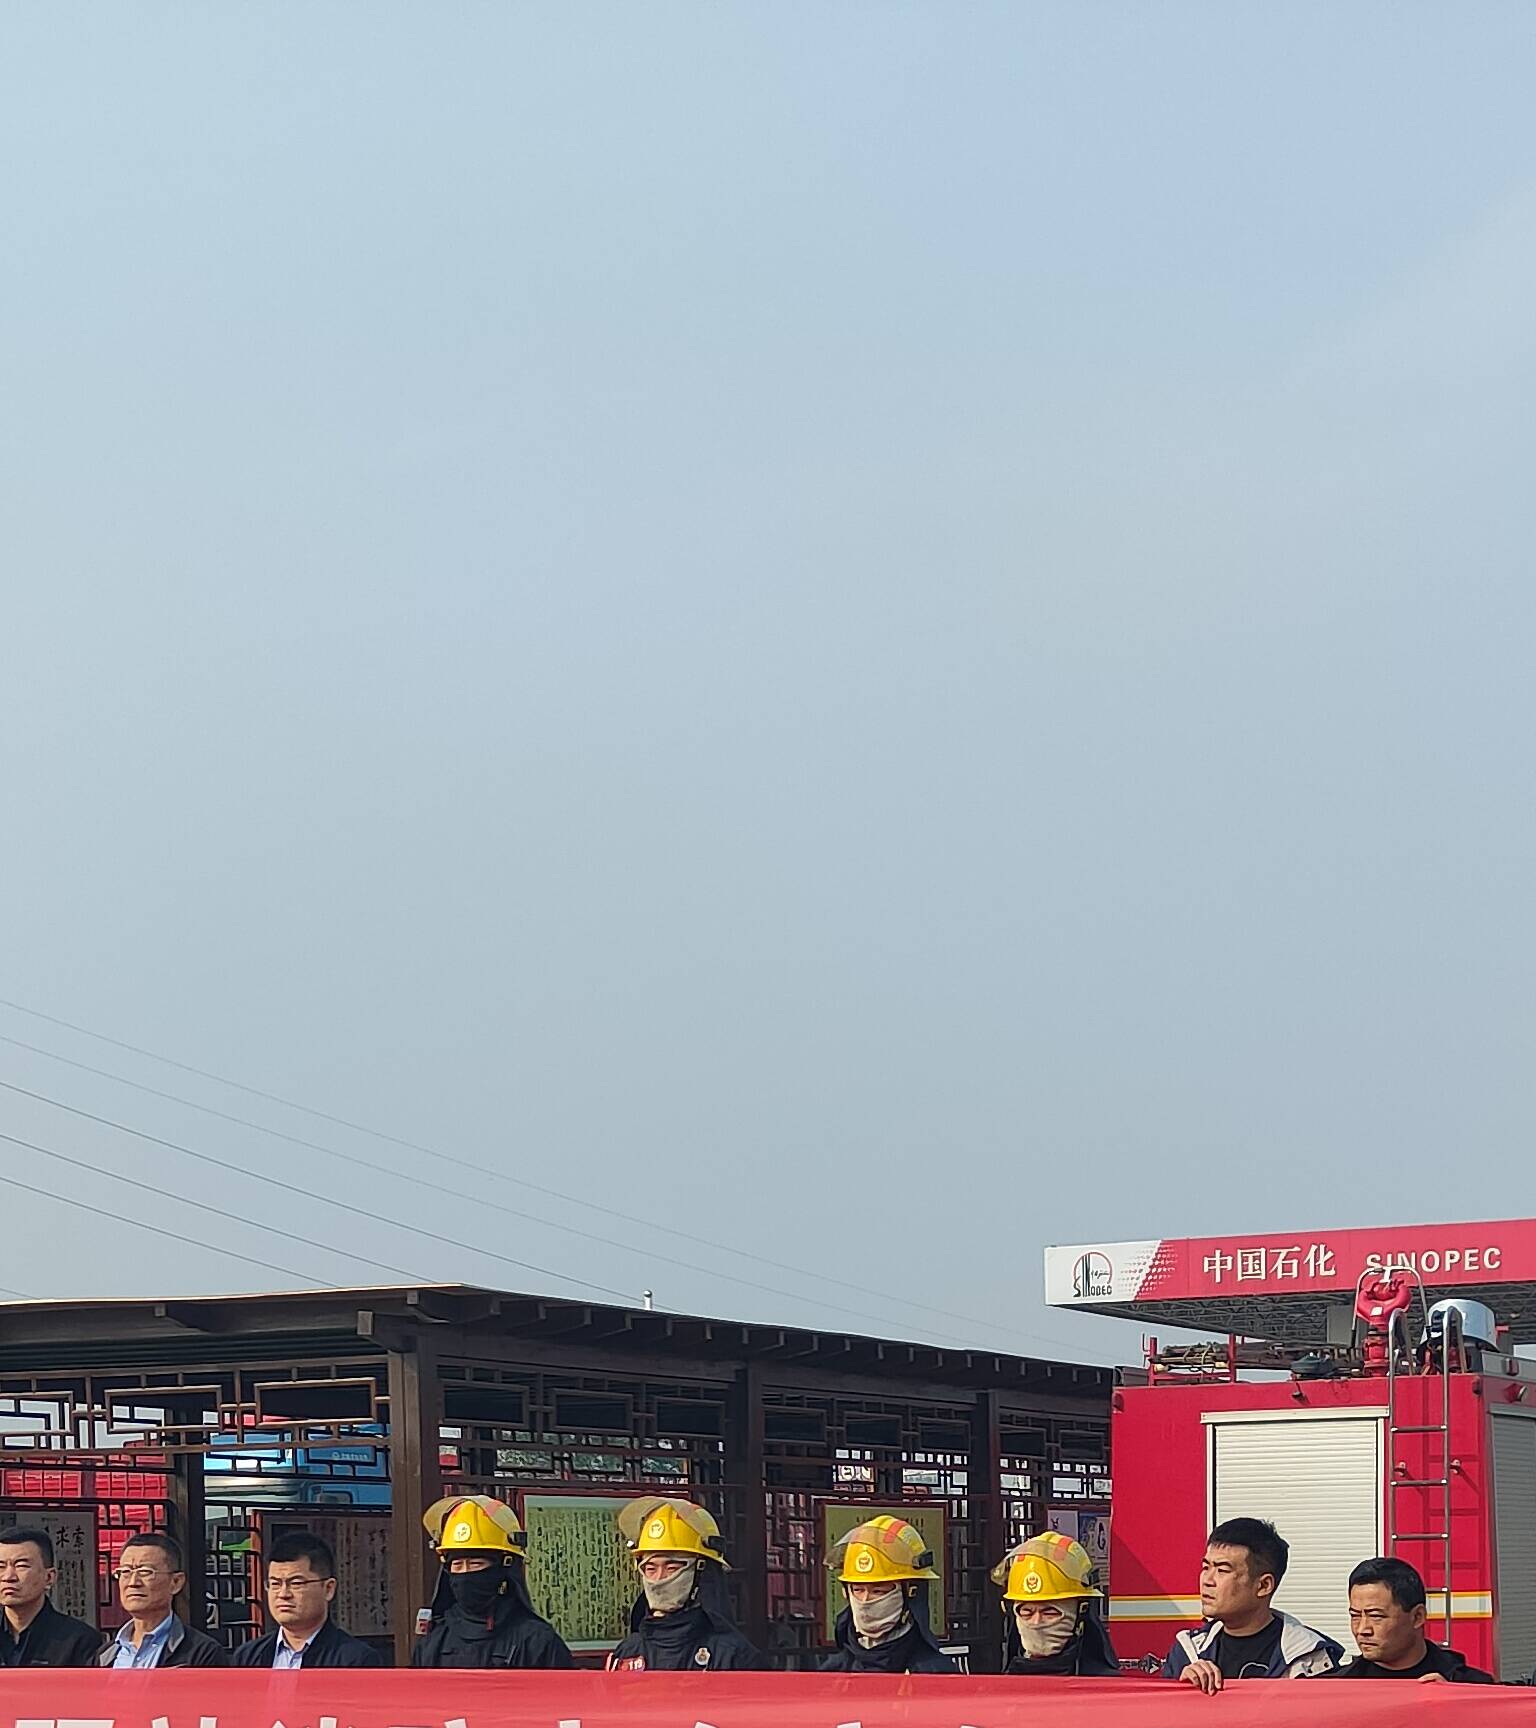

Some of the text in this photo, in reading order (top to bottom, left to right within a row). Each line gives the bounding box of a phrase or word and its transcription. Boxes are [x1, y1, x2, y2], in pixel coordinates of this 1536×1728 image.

[1204, 1244, 1336, 1283] 中国石化
[1366, 1247, 1501, 1273] SINOPEC
